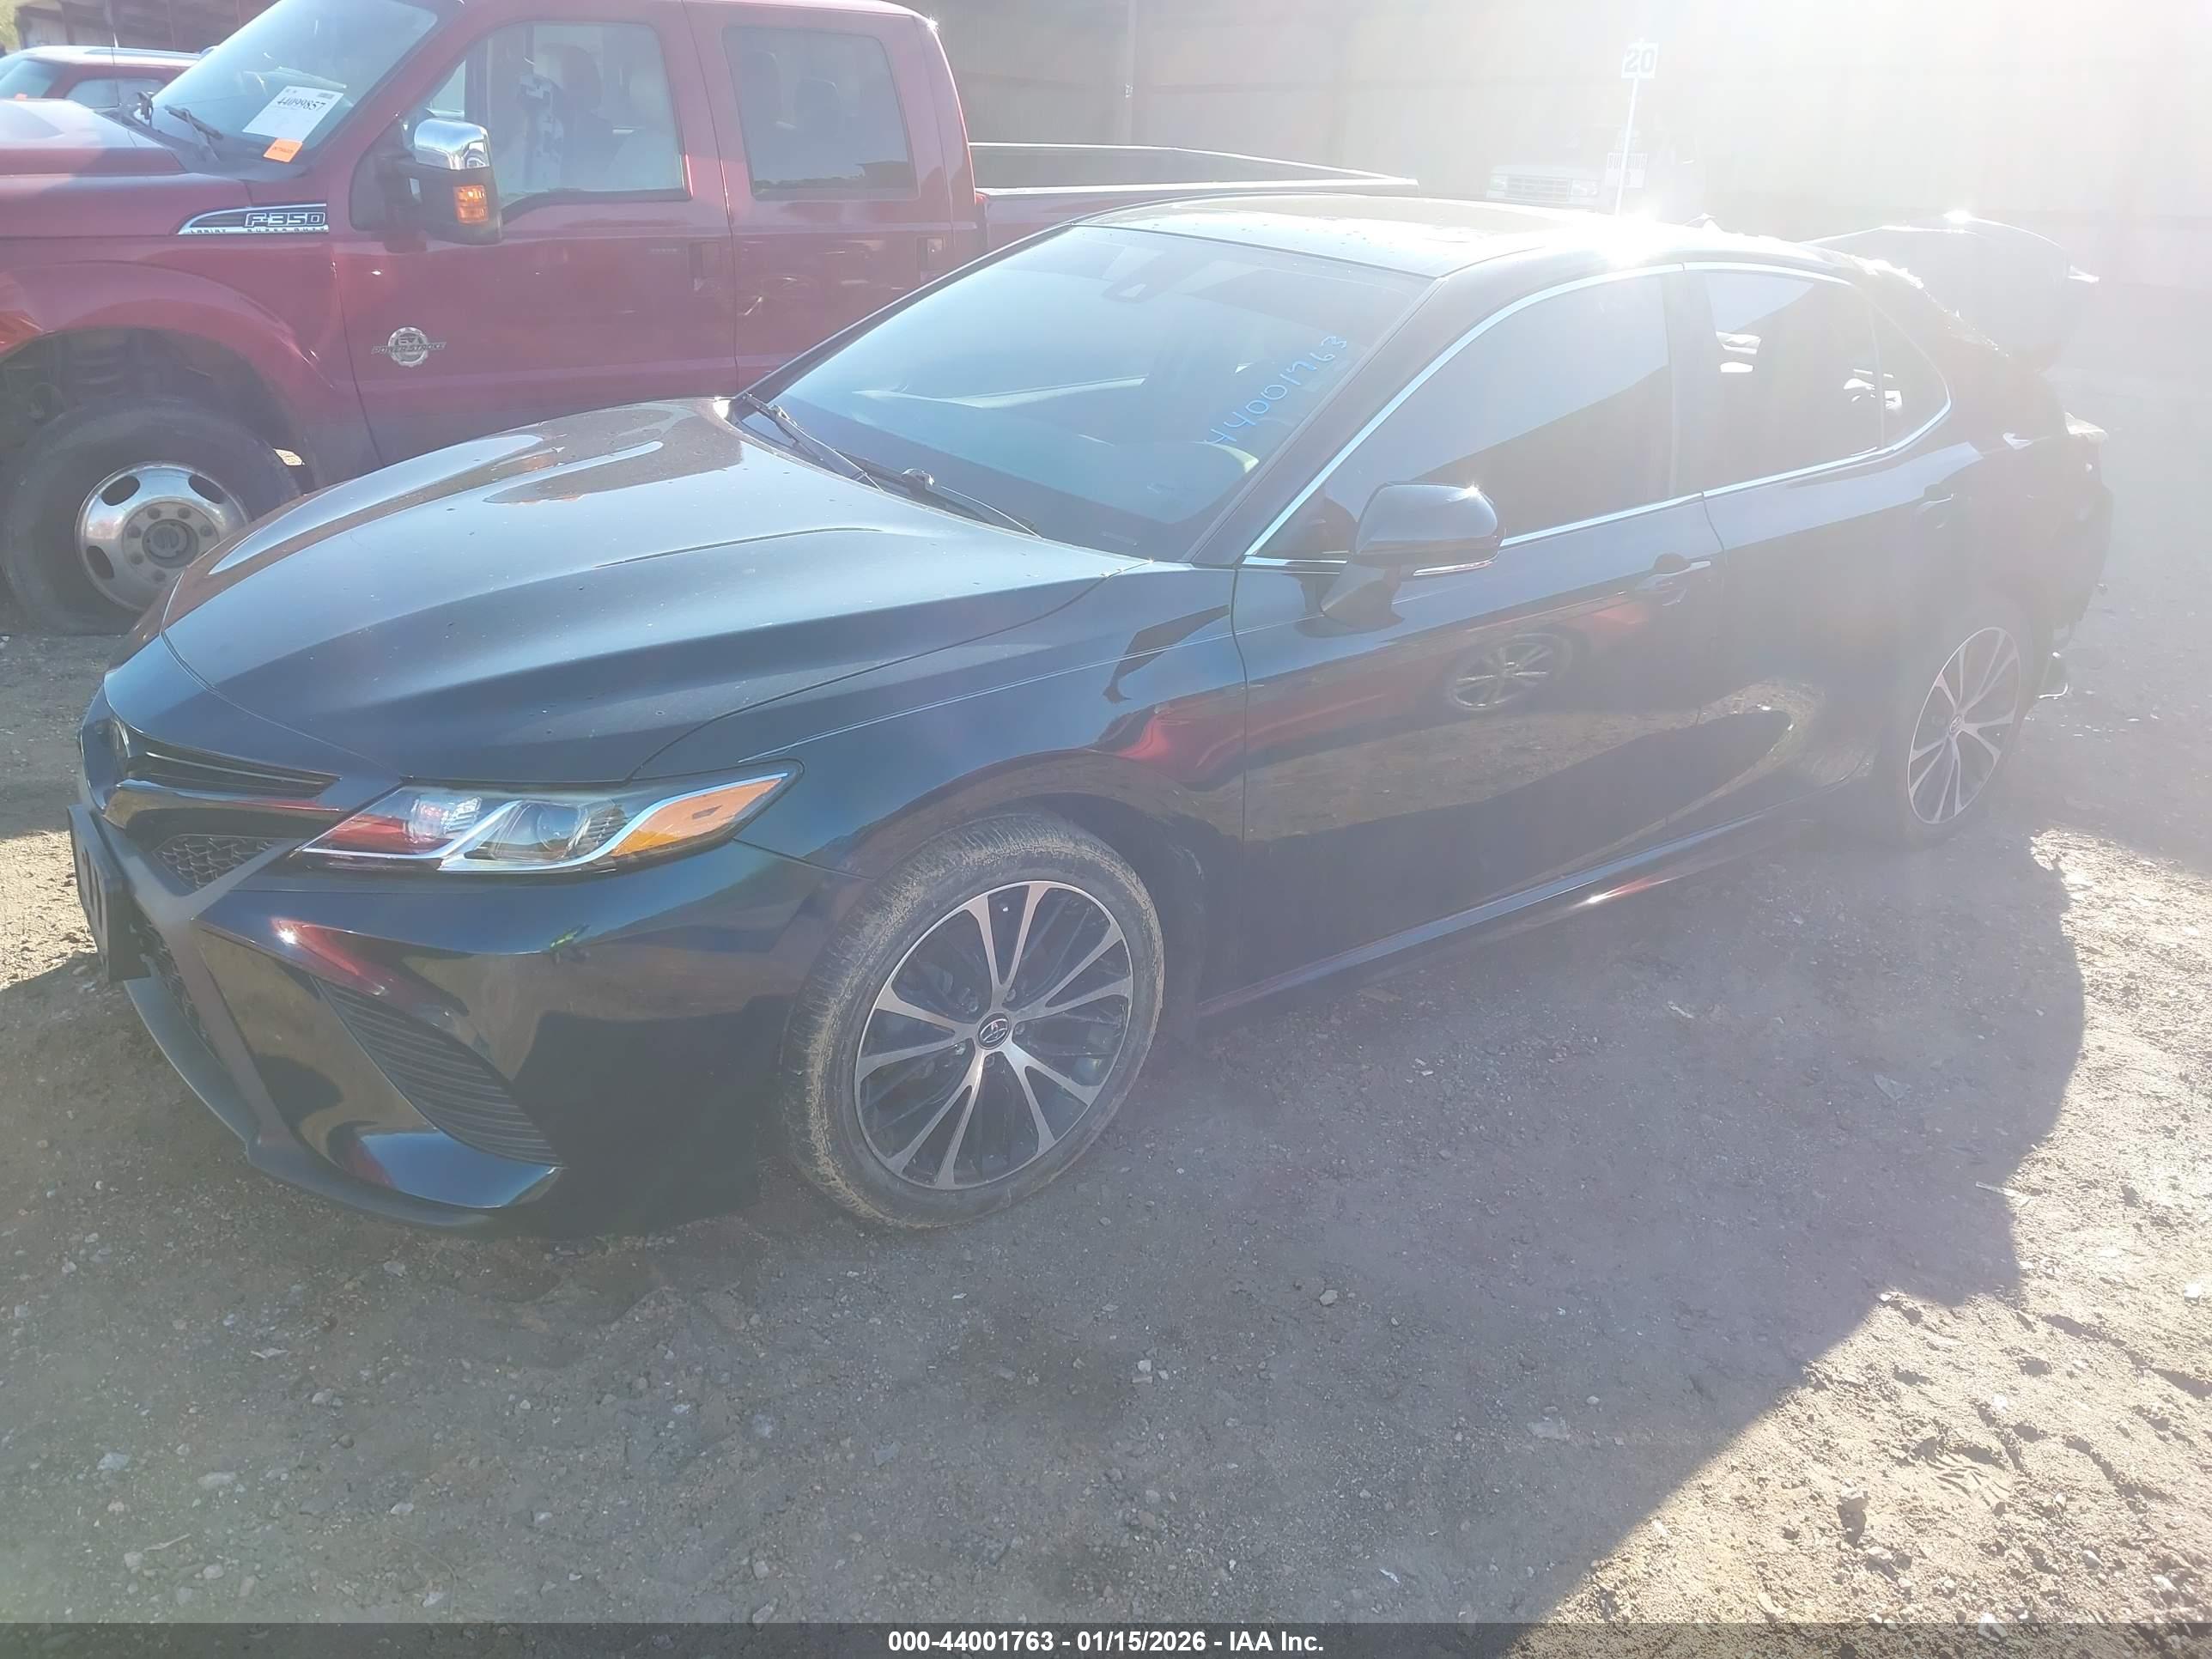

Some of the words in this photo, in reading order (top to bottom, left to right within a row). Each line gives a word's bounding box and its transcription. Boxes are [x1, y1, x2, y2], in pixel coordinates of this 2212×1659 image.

[1625, 47, 1656, 73] 20
[245, 212, 325, 228] F-350
[1203, 336, 1347, 445] 44001763
